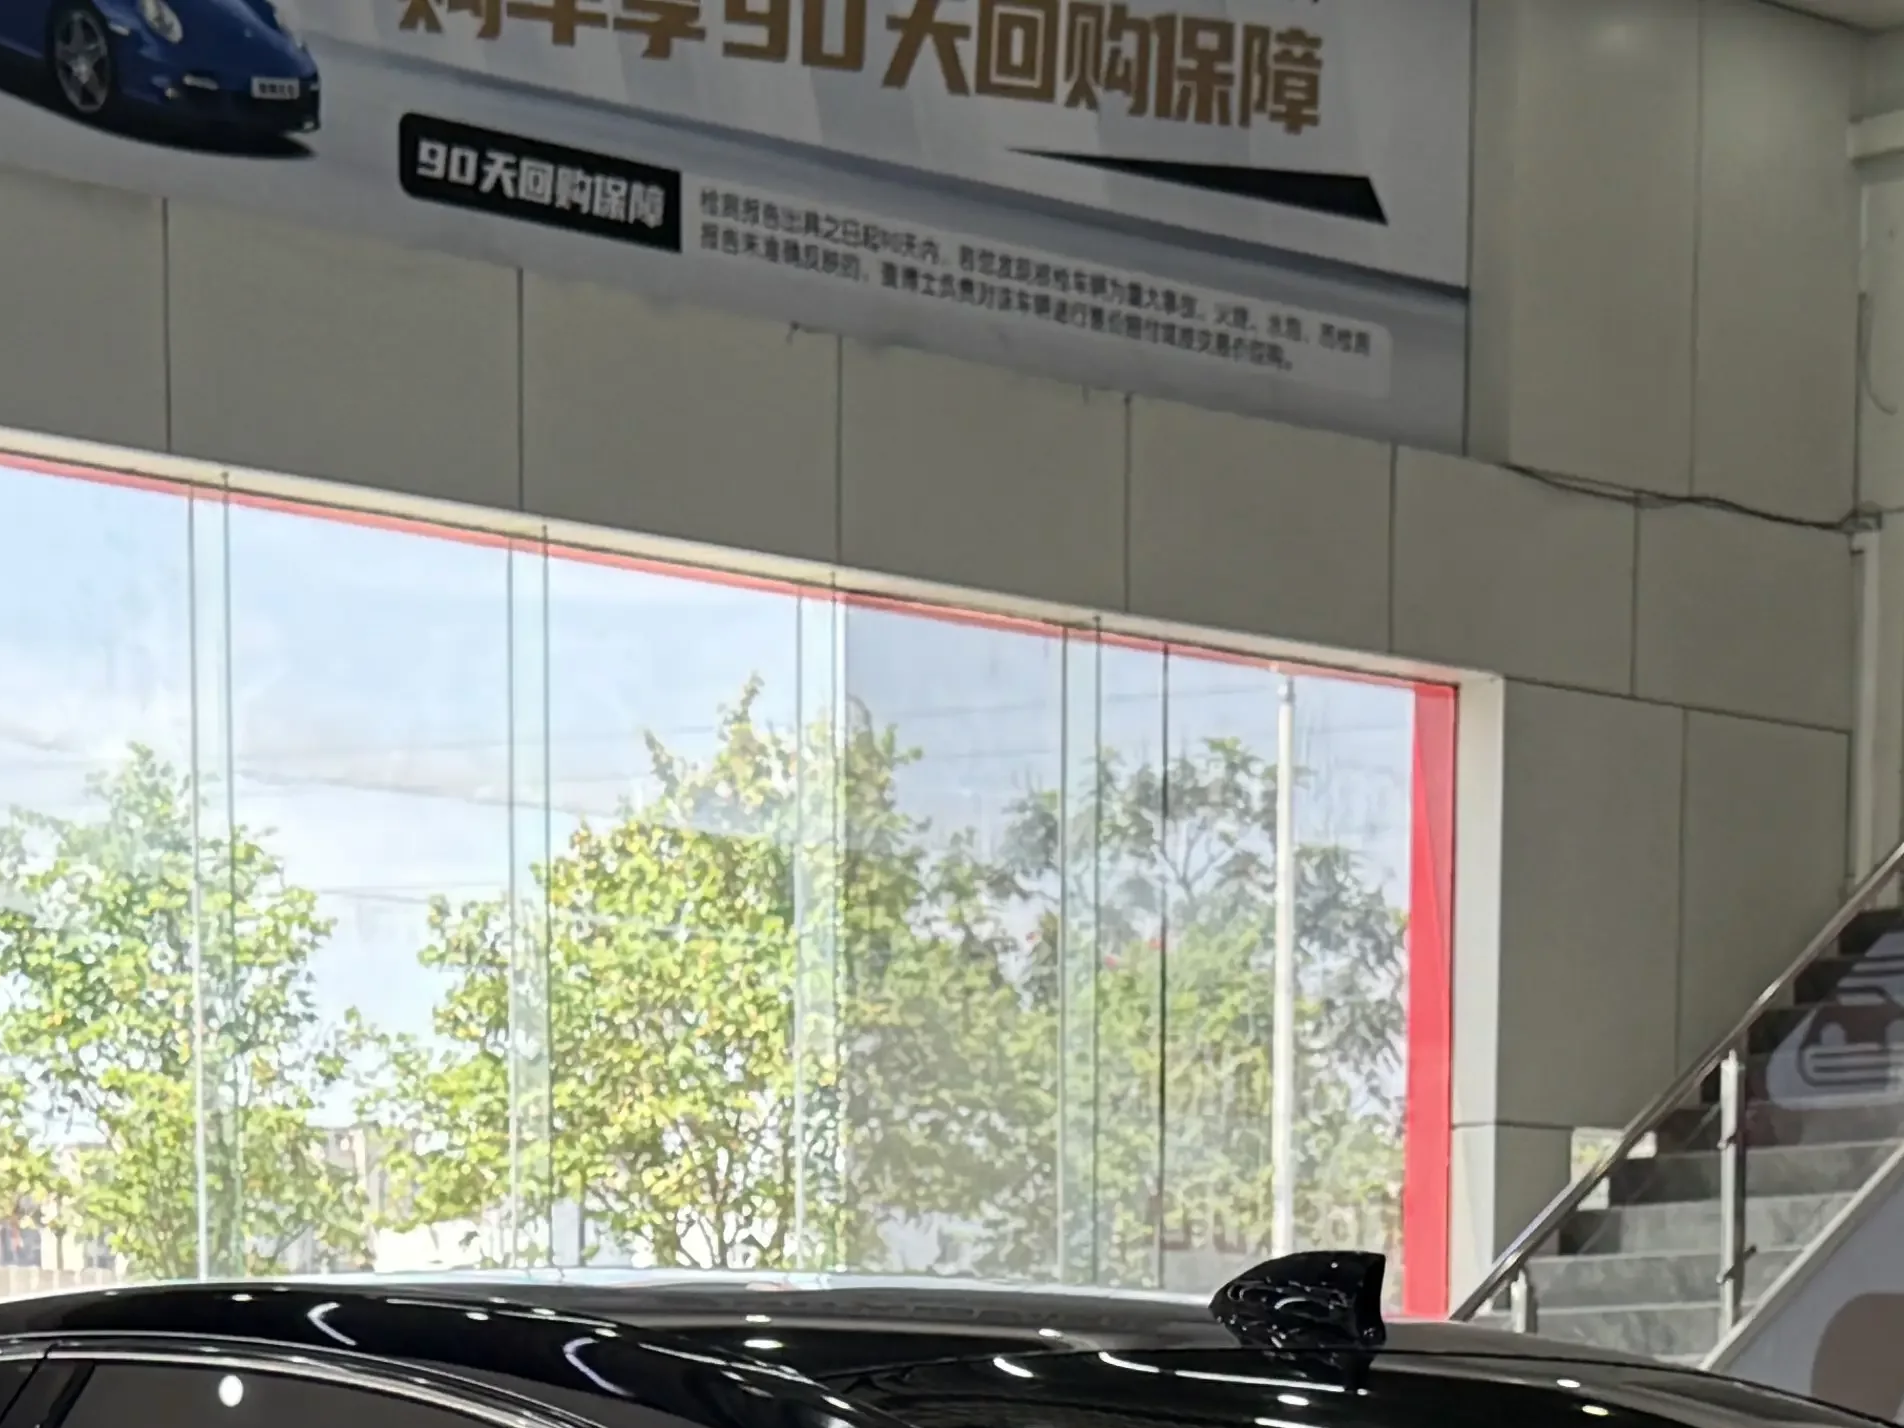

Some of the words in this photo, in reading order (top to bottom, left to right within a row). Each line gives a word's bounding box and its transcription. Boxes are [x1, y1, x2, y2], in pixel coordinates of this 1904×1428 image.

[416, 137, 666, 229] 90天回购保障
